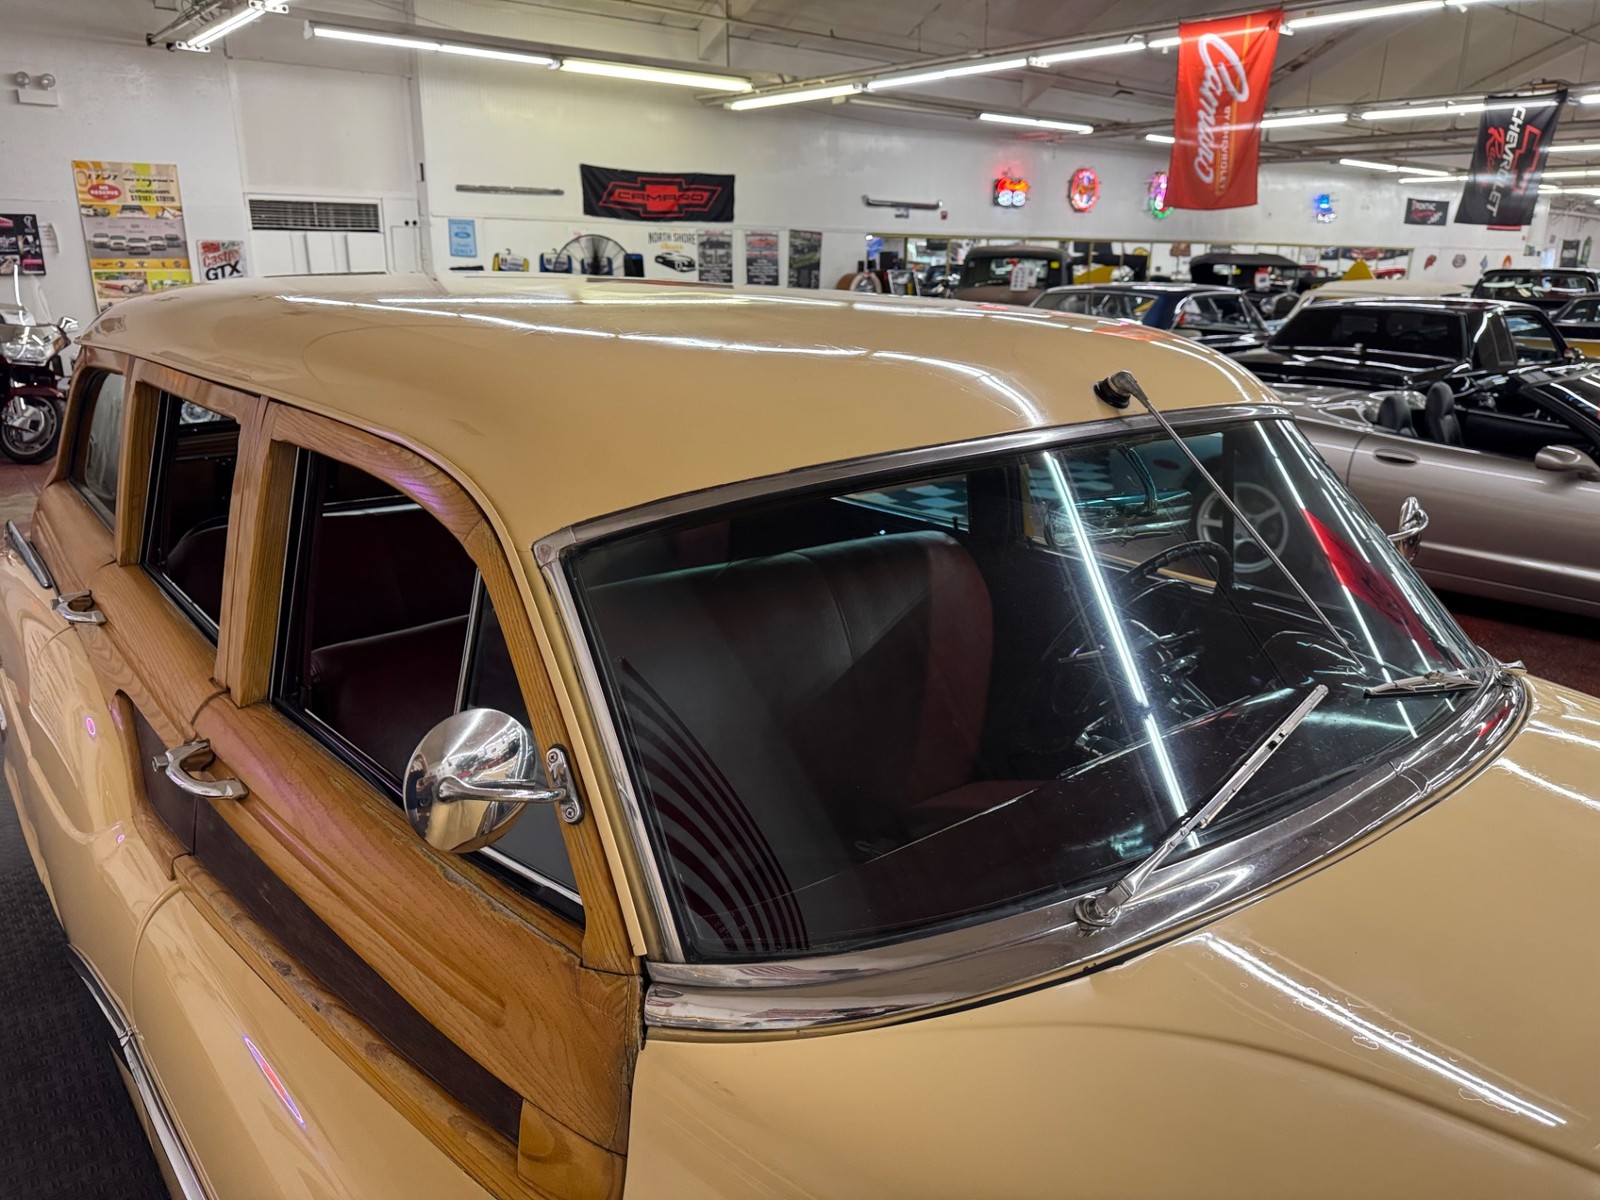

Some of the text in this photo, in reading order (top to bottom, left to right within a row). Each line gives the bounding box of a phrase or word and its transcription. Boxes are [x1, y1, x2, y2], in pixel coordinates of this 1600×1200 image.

[1194, 33, 1249, 184] Camaro
[1223, 106, 1231, 119] BY
[1486, 106, 1526, 217] CHEVROLET
[617, 191, 704, 202] CAMARO
[648, 232, 697, 245] NORTH SHORE
[203, 249, 240, 268] Castr
[205, 260, 242, 281] GTX
